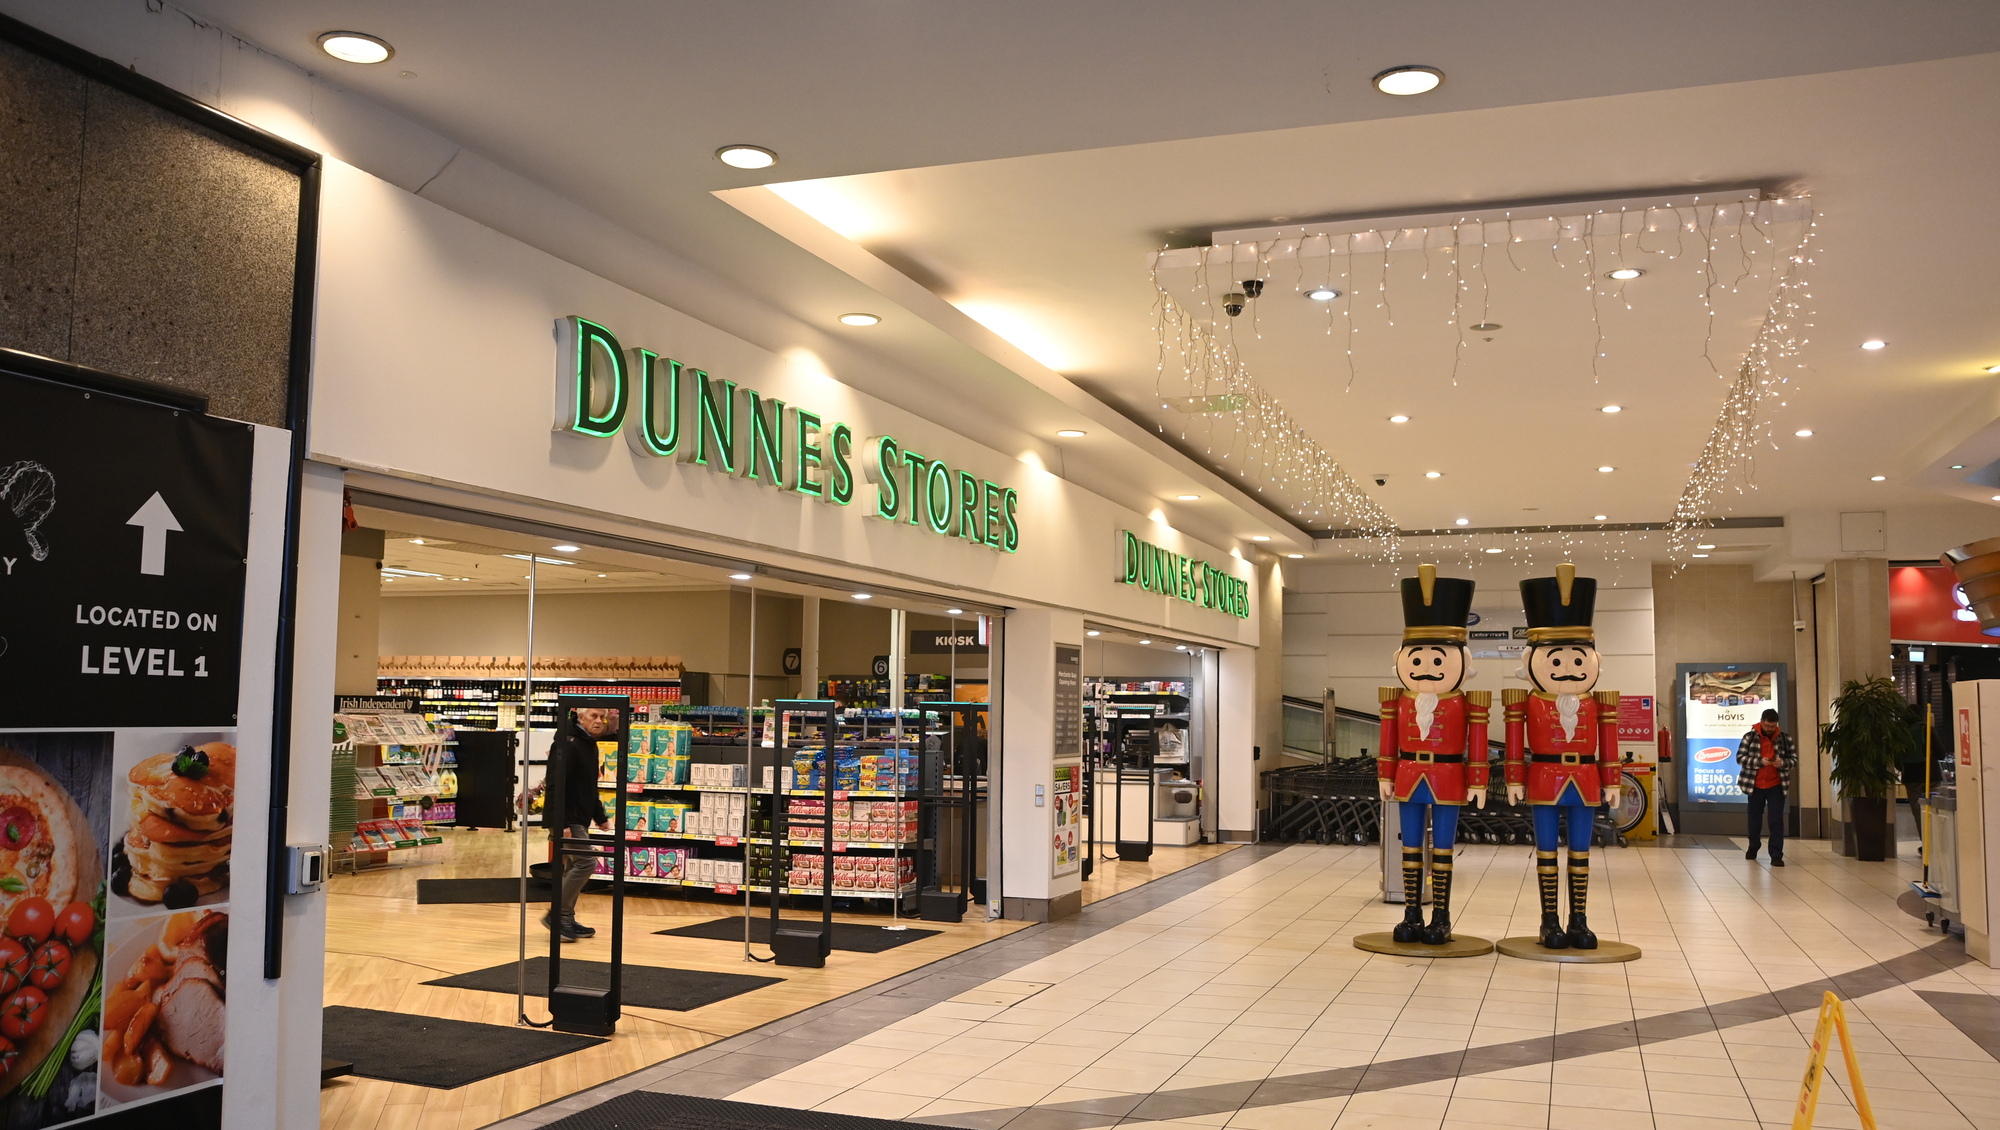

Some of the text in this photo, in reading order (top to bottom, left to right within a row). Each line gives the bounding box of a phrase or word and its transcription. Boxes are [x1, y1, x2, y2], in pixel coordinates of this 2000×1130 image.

[570, 315, 1018, 554] DUNNES STORES
[1125, 530, 1249, 619] DUNNES STORES
[76, 604, 218, 632] LOCATED ON
[935, 636, 975, 646] KIOSK
[81, 645, 209, 677] LEVEL 1
[788, 655, 796, 669] 7
[877, 661, 885, 674] 6
[340, 697, 406, 709] Irish Independent
[1694, 774, 1734, 784] BEING
[1708, 784, 1742, 796] 2023
